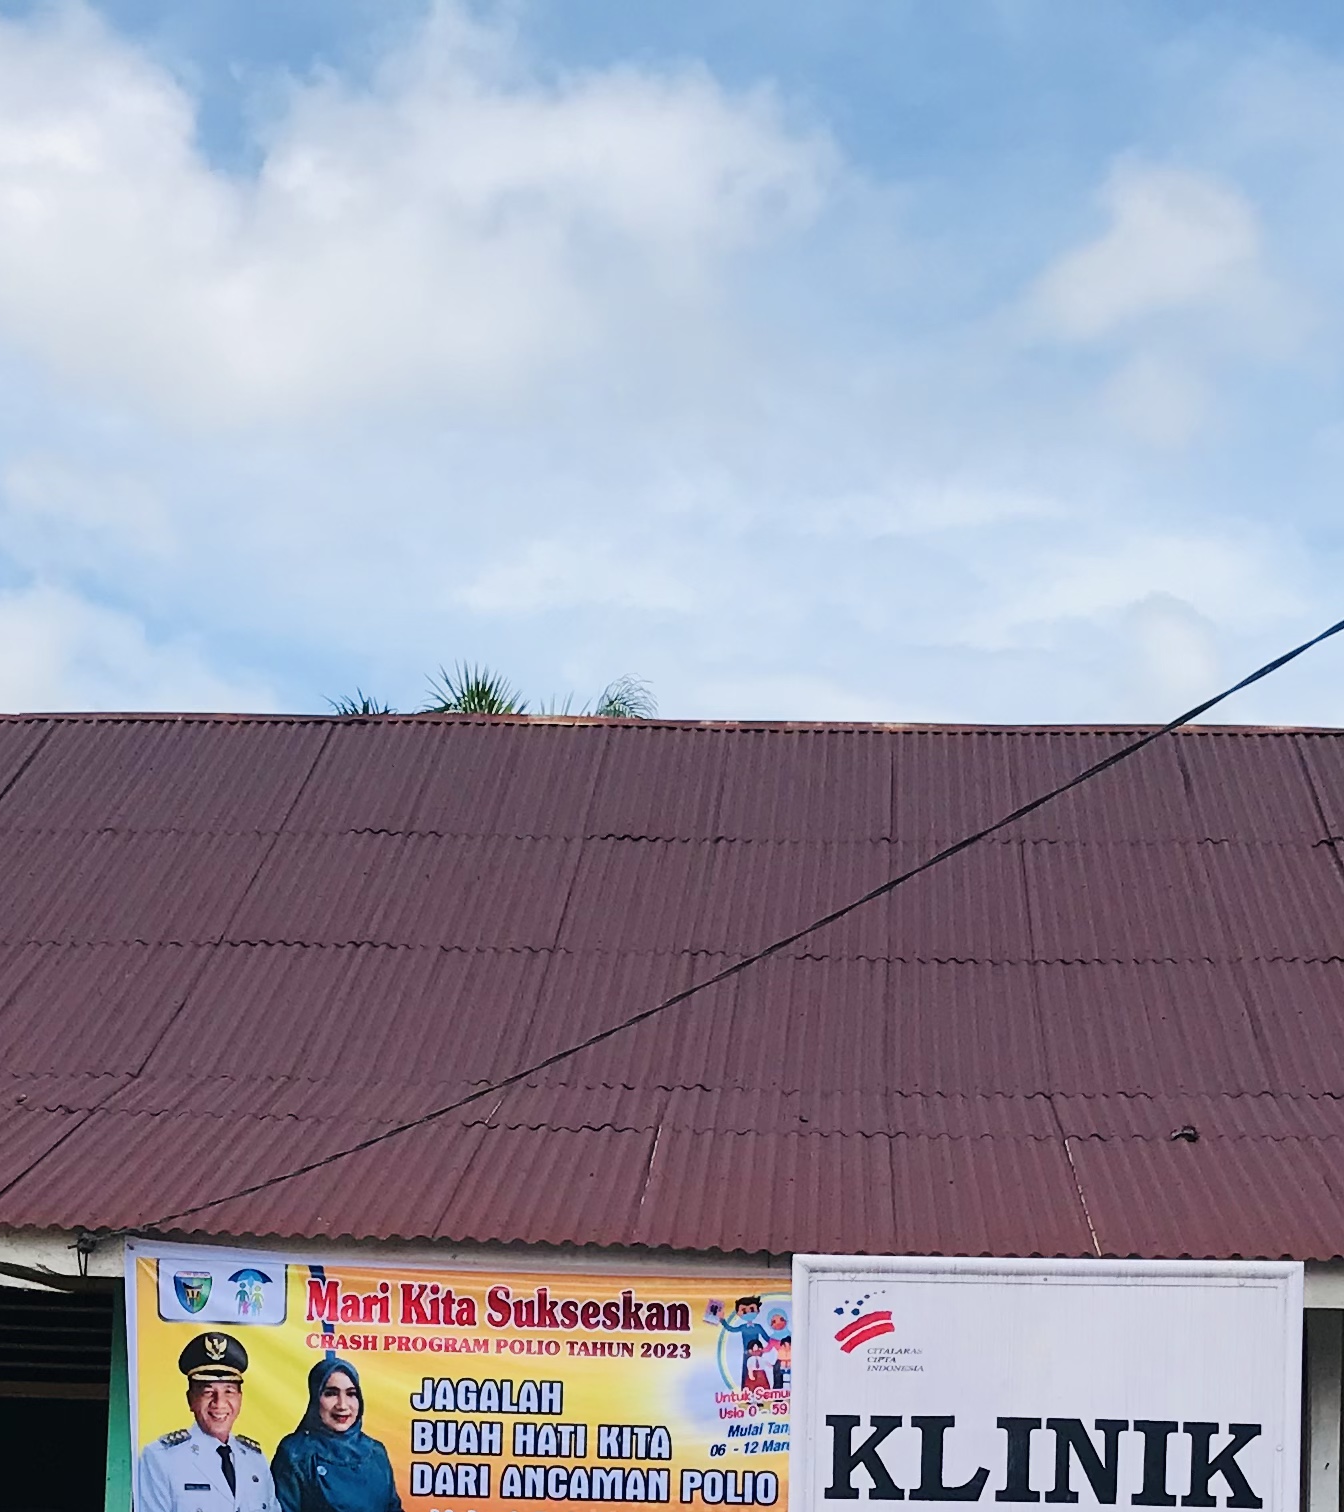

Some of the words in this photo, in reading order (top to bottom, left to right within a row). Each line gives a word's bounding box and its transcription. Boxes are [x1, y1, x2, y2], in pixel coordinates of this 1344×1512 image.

[306, 1280, 391, 1324] Mari
[399, 1283, 477, 1327] Kita
[487, 1286, 691, 1331] Sukseskan
[306, 1333, 378, 1352] CRASH
[384, 1335, 489, 1355] PROGRAM
[495, 1338, 561, 1356] POLIO
[566, 1341, 634, 1359] TAHUN
[641, 1342, 691, 1360] 2023
[410, 1377, 564, 1415] JAGALAH
[715, 1390, 751, 1403] Untuk
[756, 1388, 790, 1401] Semu
[719, 1406, 744, 1419] Usia
[748, 1405, 757, 1417] 0
[771, 1403, 788, 1415] 59
[411, 1420, 504, 1456] BUAH
[513, 1423, 588, 1459] HATI
[597, 1425, 672, 1460] KITA
[727, 1422, 765, 1438] Mulai
[767, 1421, 790, 1436] Tan
[710, 1443, 727, 1457] 06
[744, 1441, 759, 1454] 12
[824, 1414, 1263, 1509] KLINIK
[410, 1462, 490, 1498] DARI
[500, 1465, 671, 1503] ANCAMAN
[680, 1469, 779, 1506] POLIO
